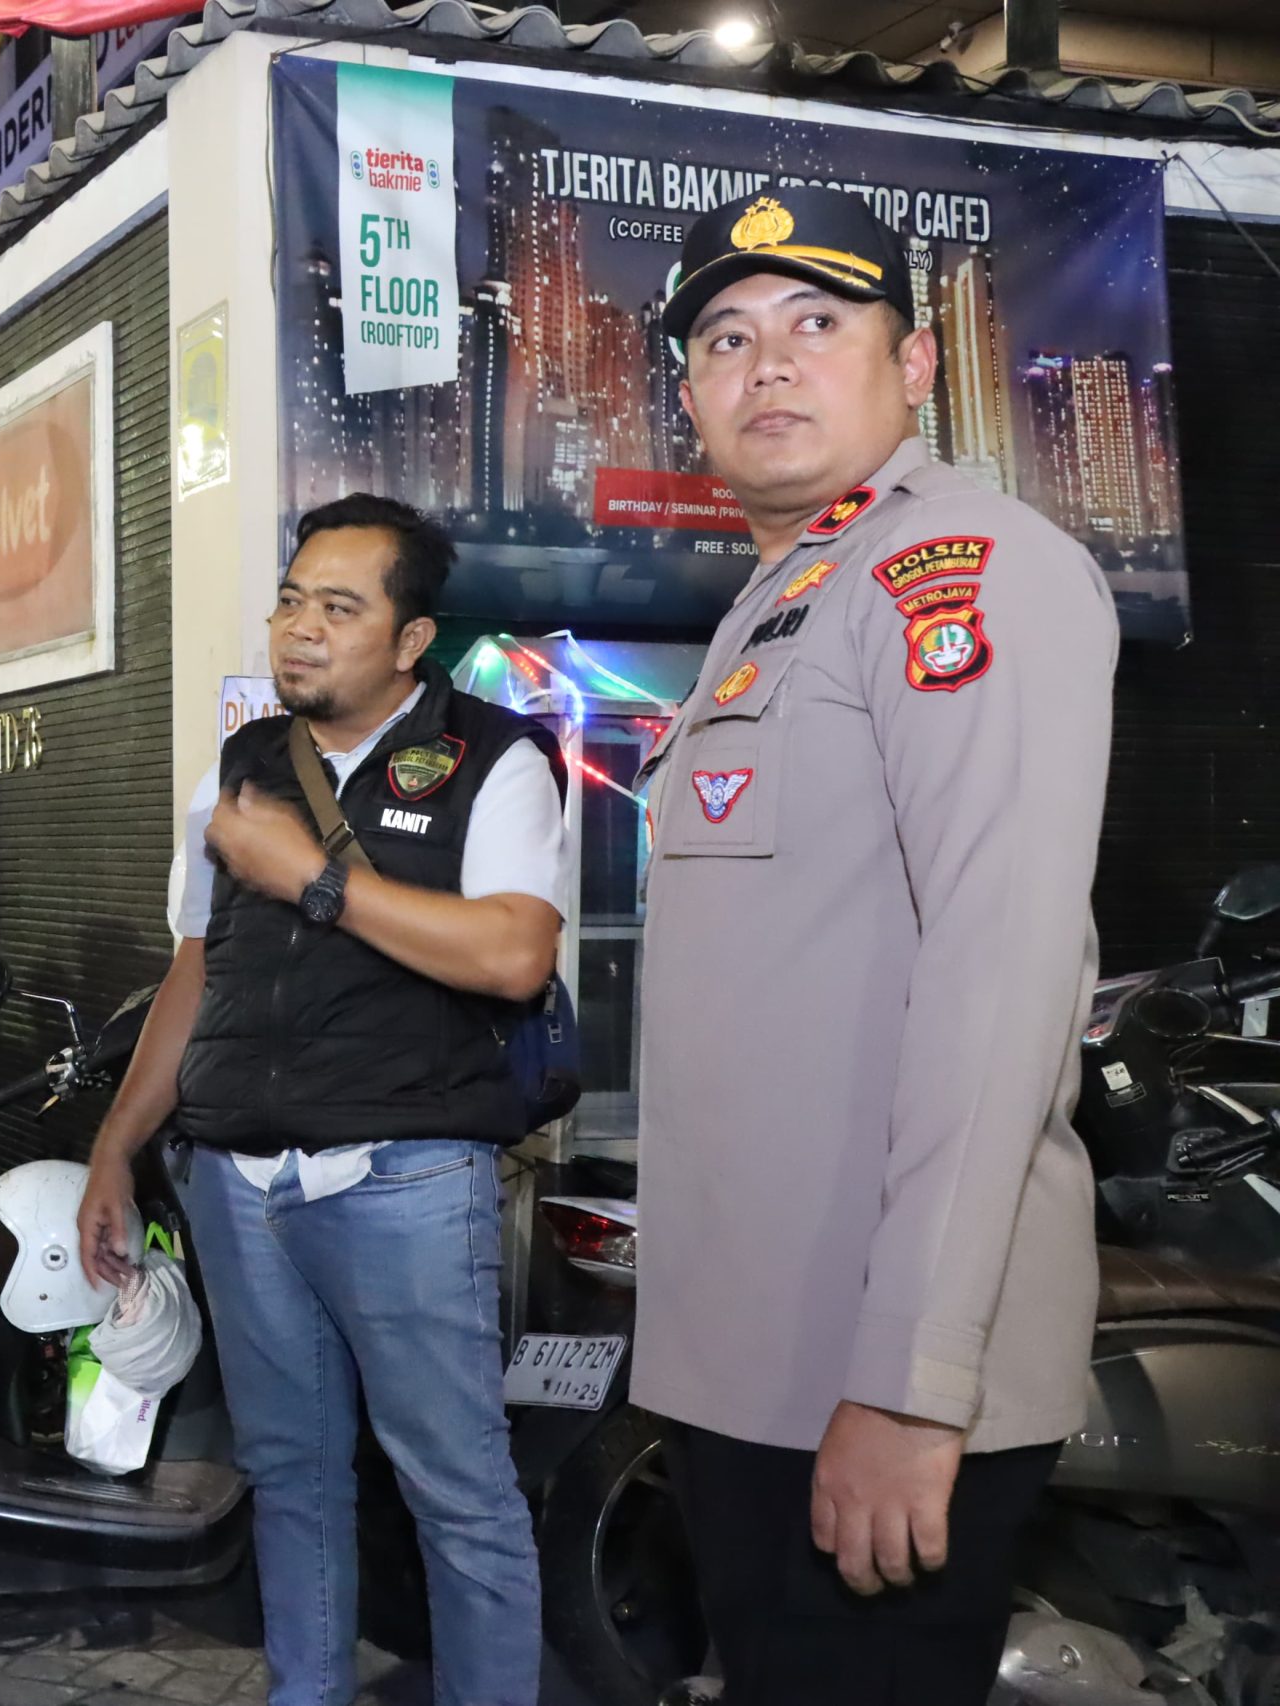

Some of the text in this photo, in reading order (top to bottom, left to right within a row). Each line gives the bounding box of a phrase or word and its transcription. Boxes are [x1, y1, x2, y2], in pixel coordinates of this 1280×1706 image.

[365, 147, 424, 173] tjerita
[368, 167, 422, 192] bakmie
[540, 149, 656, 206] TJERITA
[915, 191, 991, 243] CAFE)
[609, 217, 683, 243] (COFFEE
[360, 275, 439, 317] FLOOR
[361, 320, 439, 350] (ROOFTOP)
[608, 500, 662, 513] BIRTHDAY
[671, 503, 716, 516] SEMINAR
[887, 542, 984, 578] POLSEK
[380, 808, 433, 835] KANIT
[513, 1339, 529, 1366] B
[533, 1340, 582, 1367] 6112
